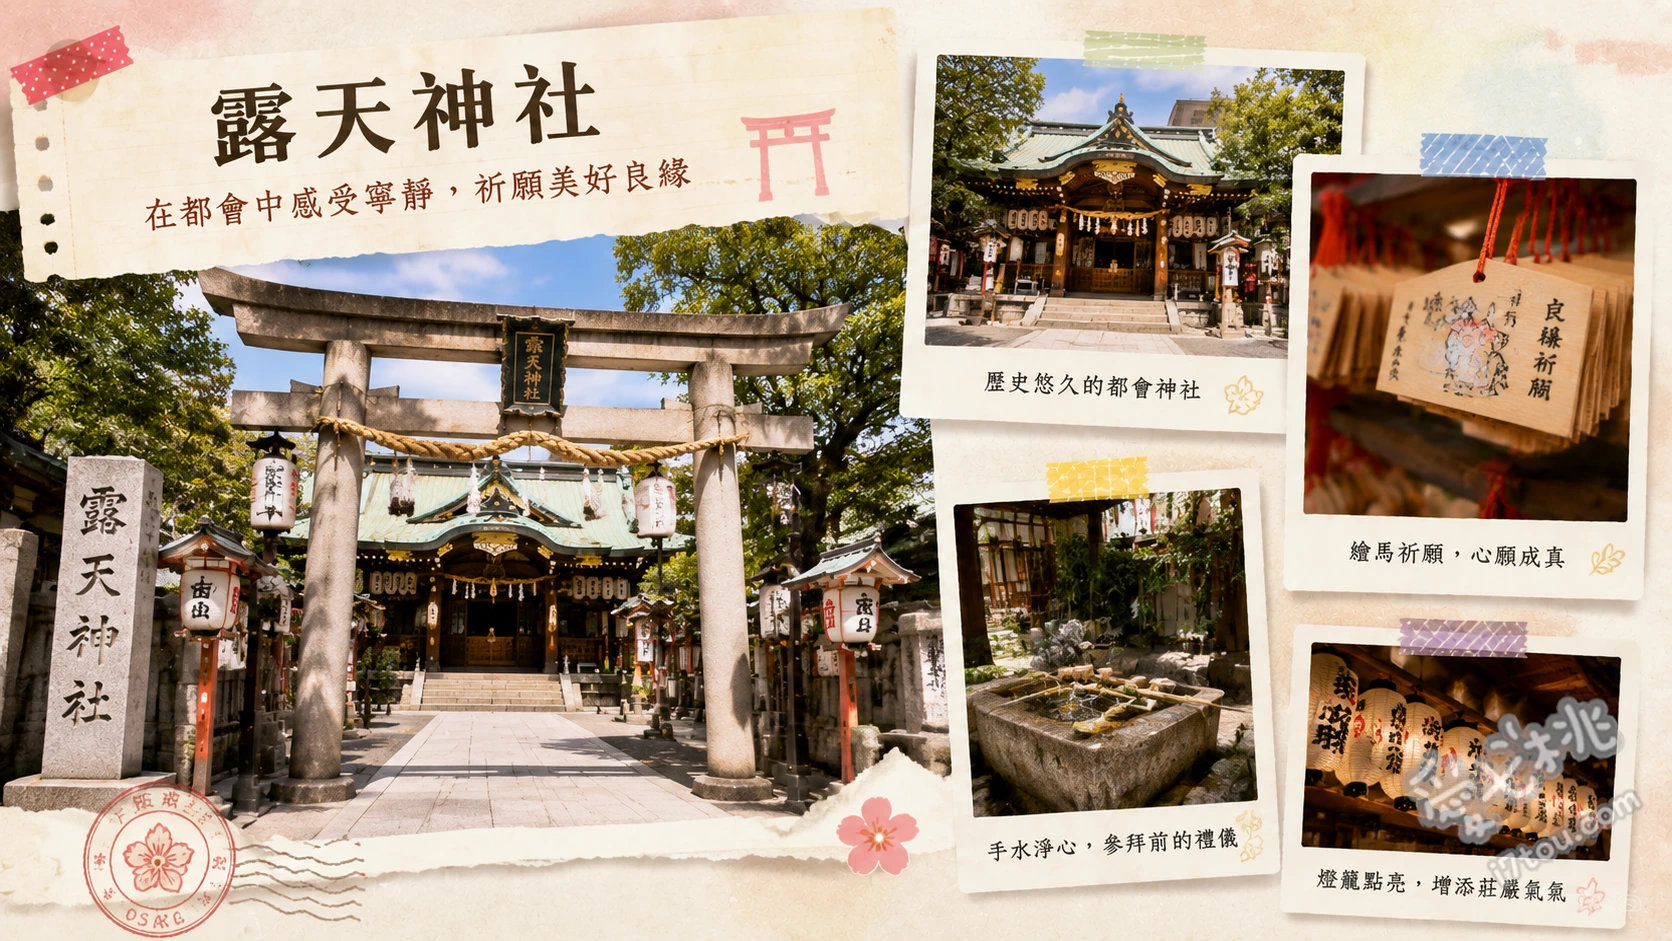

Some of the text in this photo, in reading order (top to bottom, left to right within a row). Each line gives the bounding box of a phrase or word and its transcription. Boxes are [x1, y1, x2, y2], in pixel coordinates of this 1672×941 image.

[211, 62, 600, 166] 露天神社
[146, 157, 692, 231] 在都會中感受寧靜，祈願美好良緣
[1350, 541, 1565, 569] 繪馬祈願，心願成真
[62, 485, 128, 725] 露天神社
[988, 828, 1239, 862] 手水淨心，參拜前的禮儀
[1316, 868, 1567, 903] 燈籠點亮，增添莊嚴氣氣
